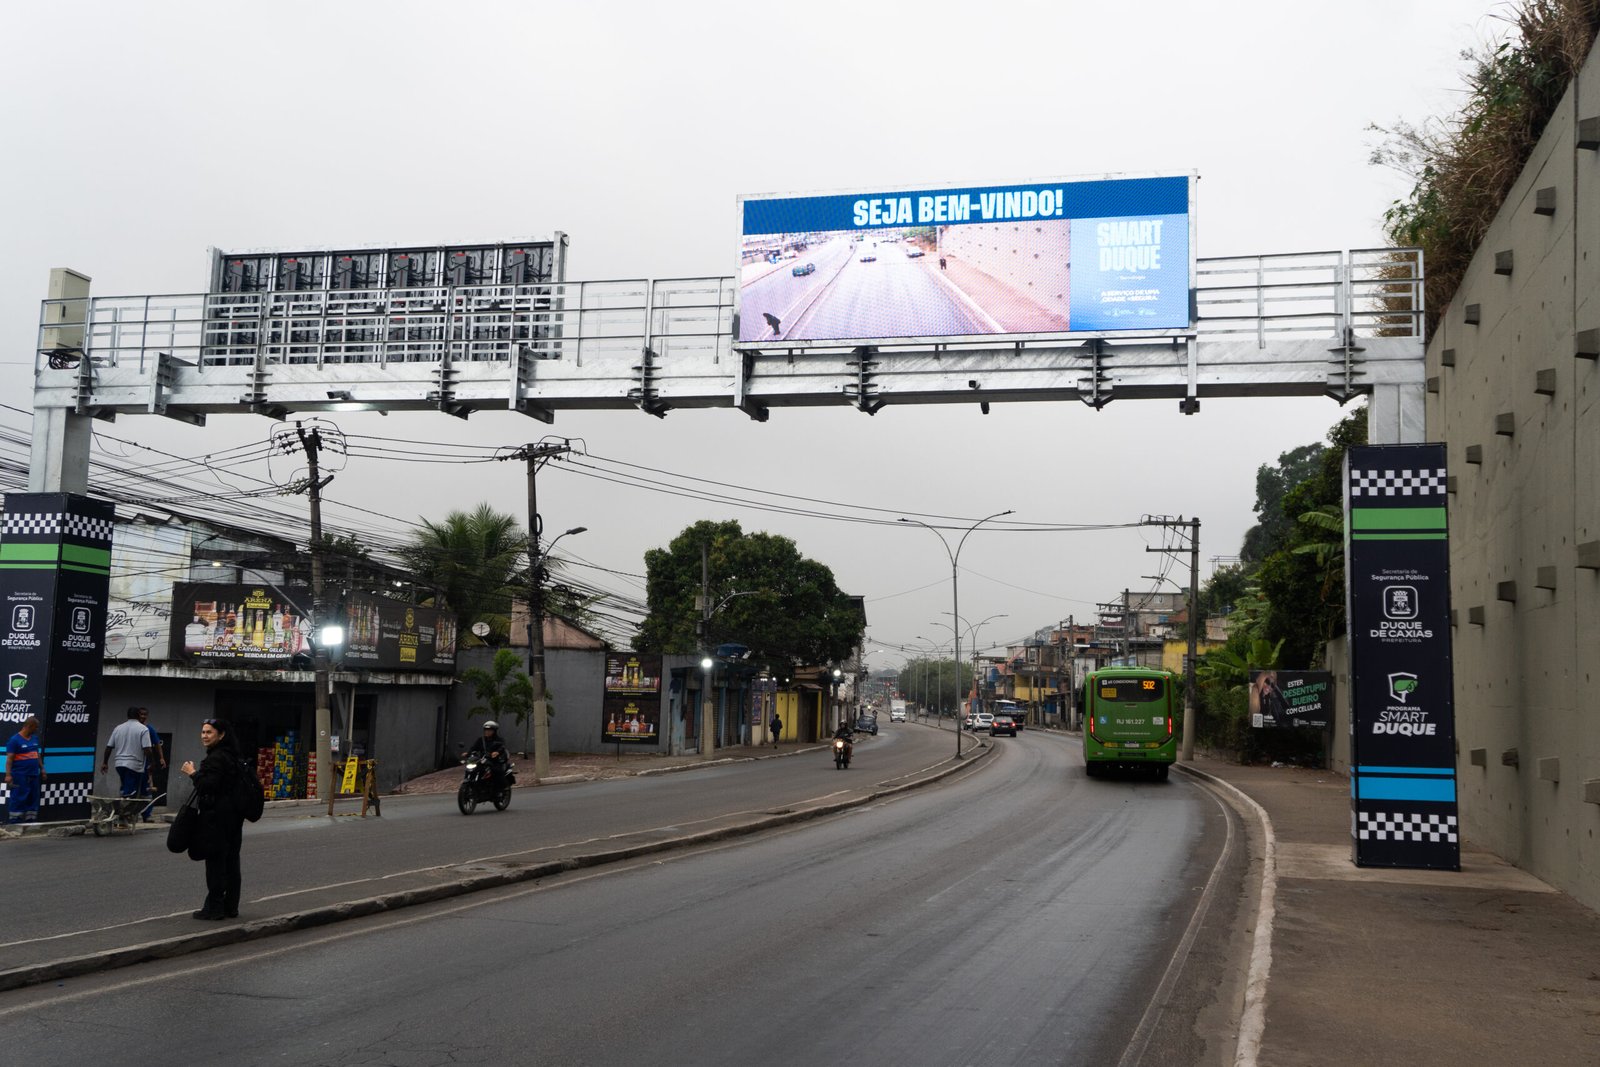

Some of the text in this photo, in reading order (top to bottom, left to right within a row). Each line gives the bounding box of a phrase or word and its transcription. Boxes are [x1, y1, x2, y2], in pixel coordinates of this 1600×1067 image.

[853, 189, 1063, 226] SEJA BEM-VINDO!
[1097, 220, 1163, 246] SMART
[1100, 246, 1161, 272] DUQUE
[1380, 621, 1423, 629] DUQUE
[68, 634, 91, 642] DUQUE
[1388, 630, 1433, 638] CAXIAS
[72, 641, 96, 649] CAXIAS
[1143, 680, 1155, 689] 502
[1287, 679, 1304, 688] ESTER
[1283, 682, 1327, 698] DESENTUPIU
[1292, 693, 1319, 706] BUEIRO
[0, 703, 31, 713] SMART
[60, 704, 87, 713] SMART
[1298, 703, 1322, 713] CELULAR
[55, 713, 90, 724] DUQUE
[1379, 711, 1429, 722] SMART
[1372, 722, 1437, 737] DUQUE
